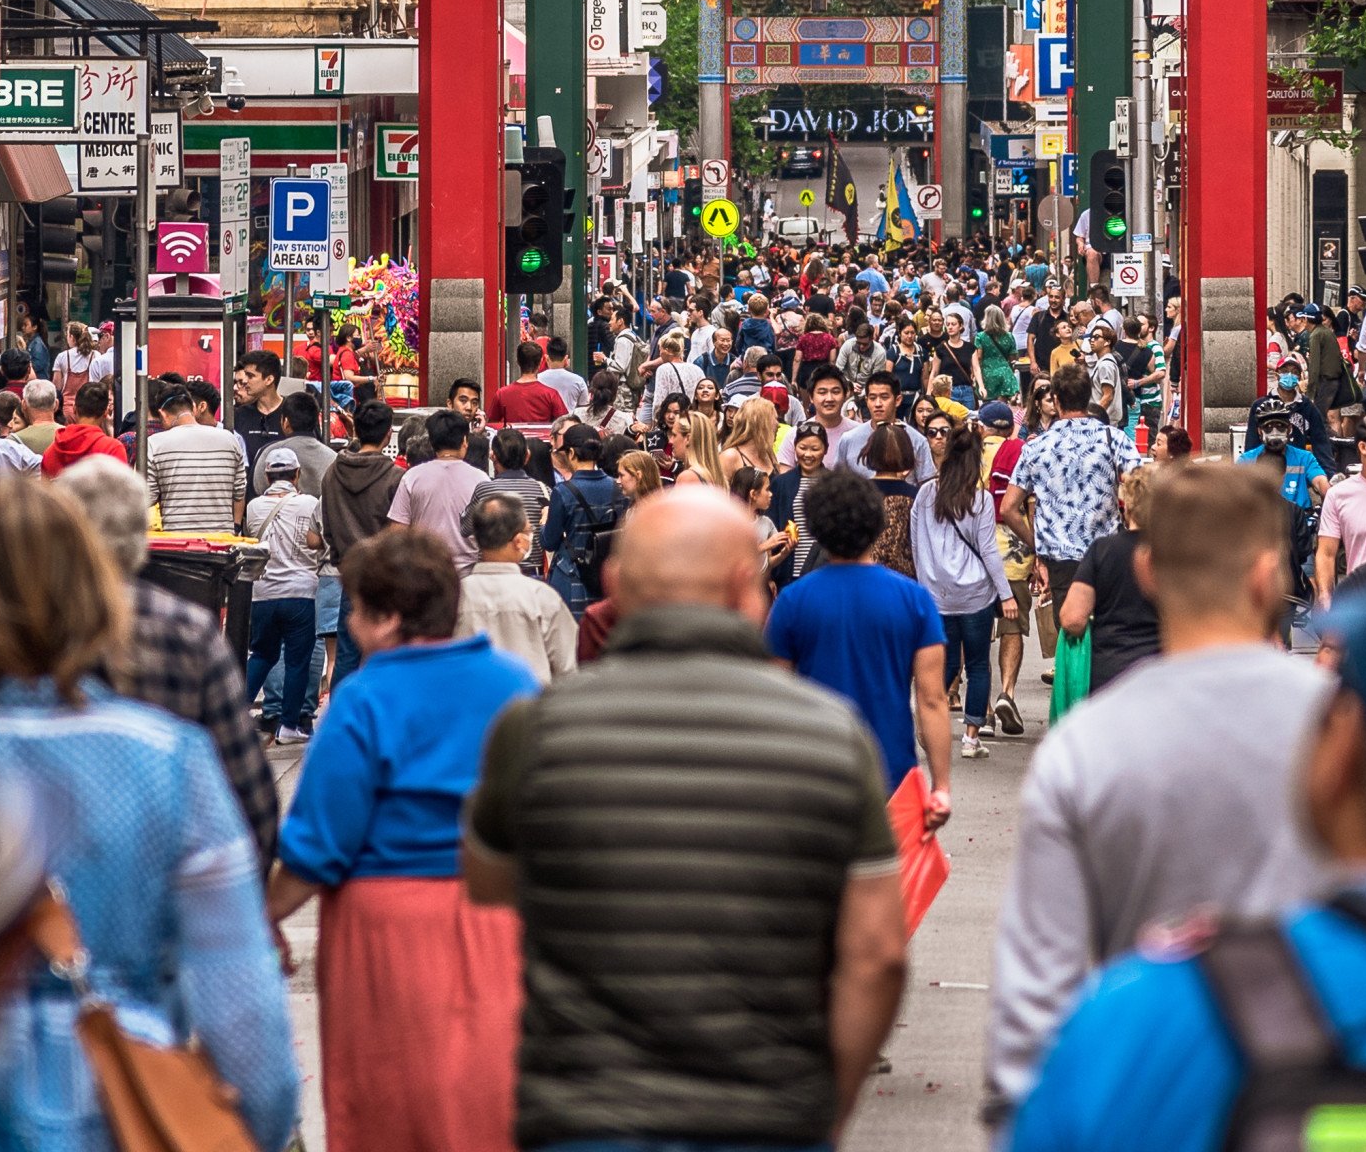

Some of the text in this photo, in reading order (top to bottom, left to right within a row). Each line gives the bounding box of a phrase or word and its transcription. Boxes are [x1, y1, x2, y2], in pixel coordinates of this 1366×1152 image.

[642, 21, 658, 33] BQ
[1266, 89, 1299, 99] CARLTON
[1117, 103, 1128, 118] ONE
[84, 112, 136, 135] CENTRE
[768, 108, 934, 133] DAVID JON
[150, 123, 172, 135] TREET
[1117, 122, 1128, 134] WAY
[84, 142, 173, 157] MEDICAL NIC
[1012, 184, 1030, 194] NZ
[286, 191, 315, 232] P
[272, 243, 327, 253] PAY STATION
[273, 253, 320, 266] AREA 643
